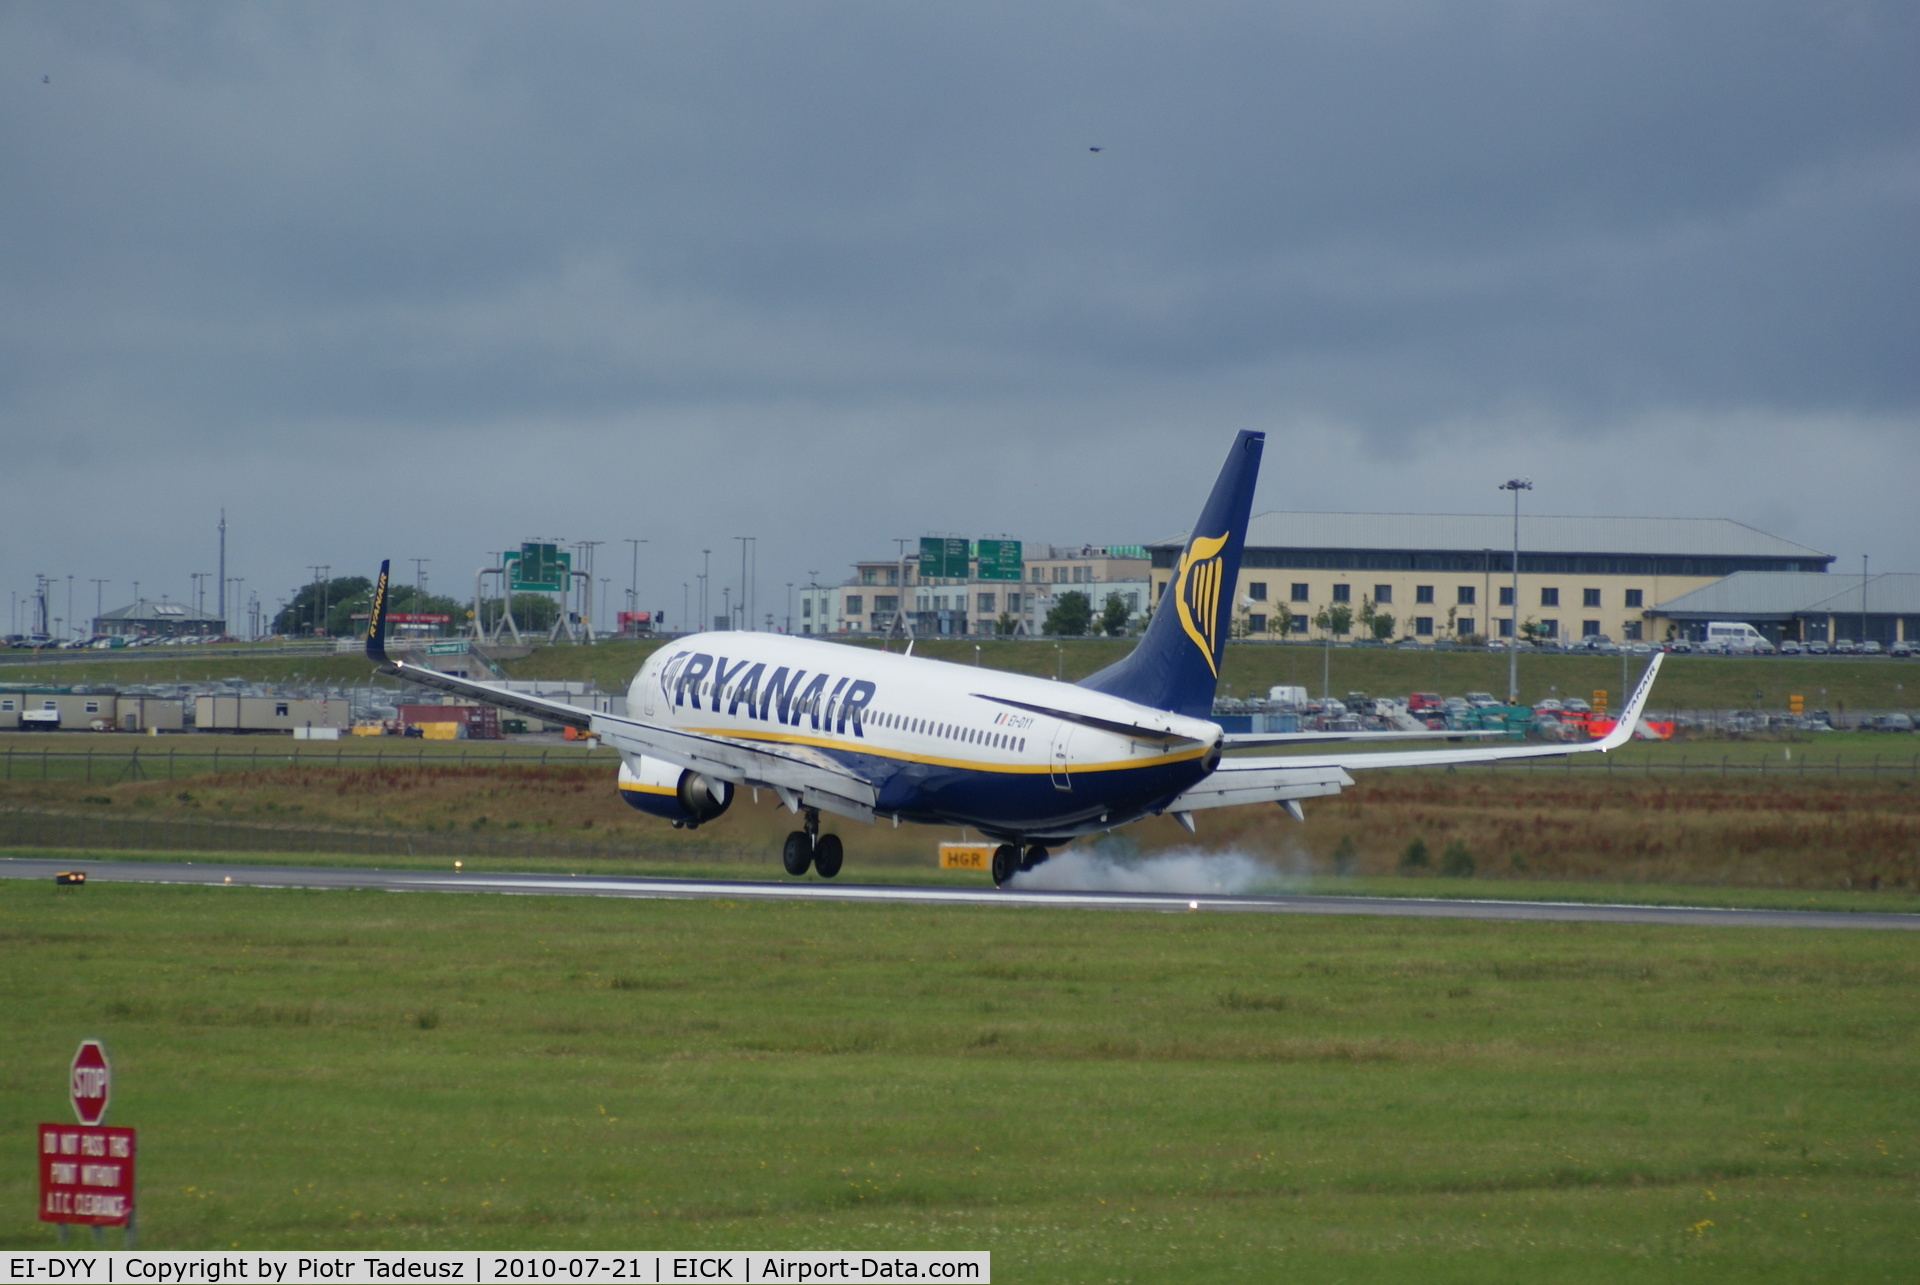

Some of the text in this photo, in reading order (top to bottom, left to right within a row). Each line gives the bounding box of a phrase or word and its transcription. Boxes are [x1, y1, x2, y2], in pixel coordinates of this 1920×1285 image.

[369, 572, 388, 638] RYANAIR
[674, 651, 877, 738] RYANAIR
[1620, 665, 1656, 726] RYANAIR
[1007, 715, 1035, 729] EI-DYY
[947, 851, 981, 867] HGR
[73, 1067, 106, 1099] STOP
[81, 1134, 106, 1157] PASS
